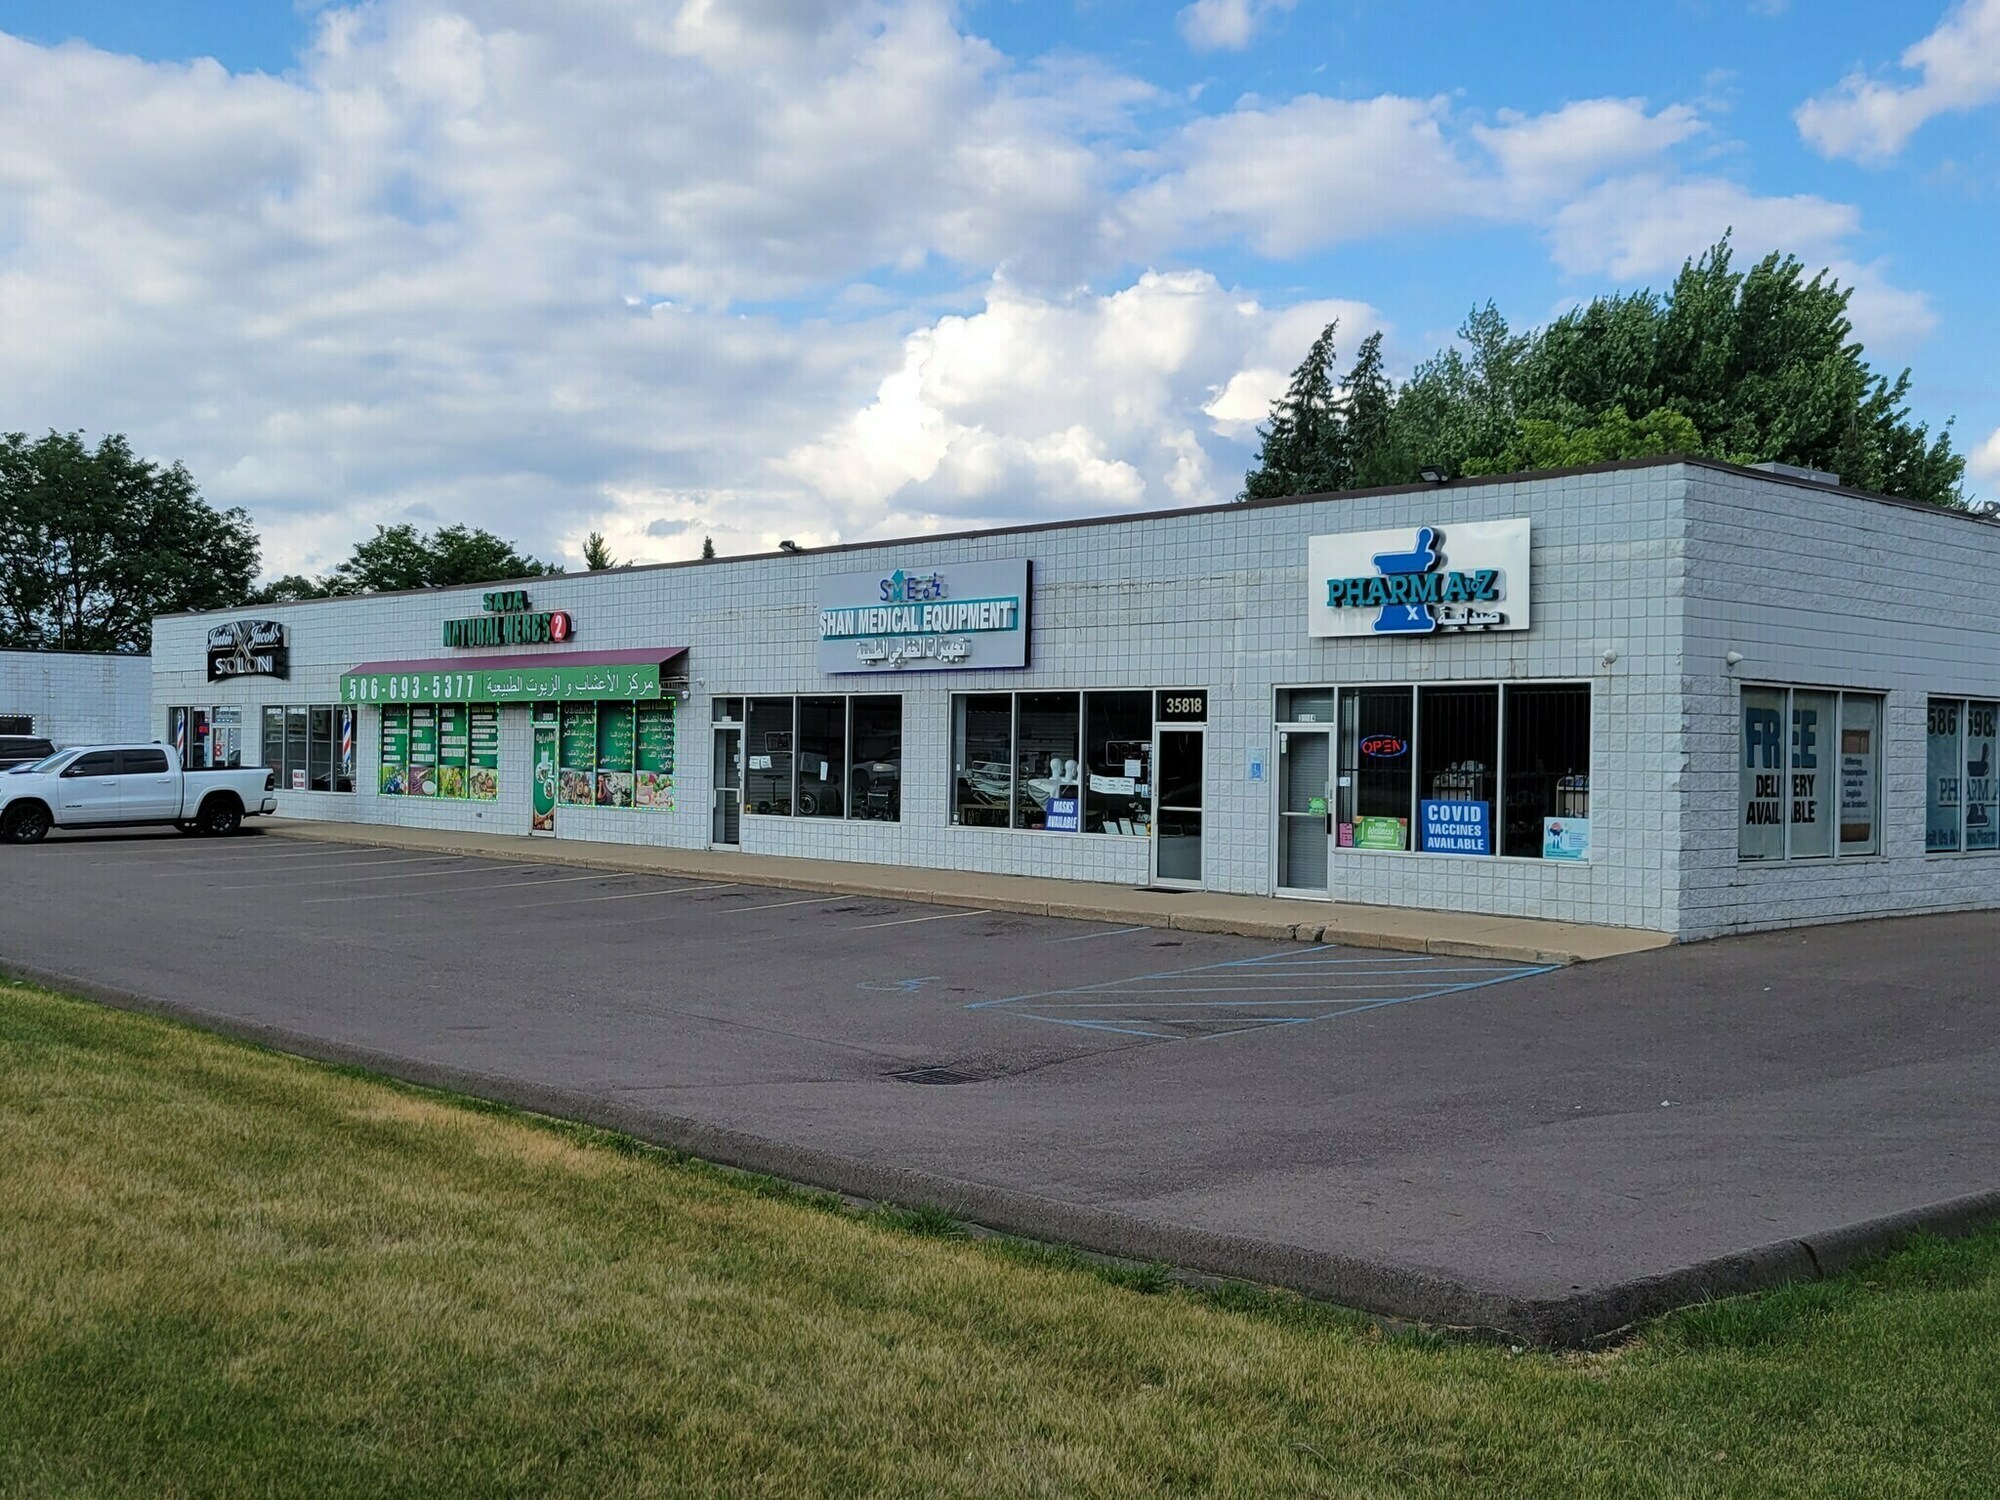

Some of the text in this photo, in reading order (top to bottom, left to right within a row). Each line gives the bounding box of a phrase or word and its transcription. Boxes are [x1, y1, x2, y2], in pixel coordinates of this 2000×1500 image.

[443, 612, 563, 648] NATURAL HERBS 2
[819, 600, 1012, 637] SHAN MEDICAL EQUIPMENT
[486, 675, 523, 698] الطبيعية
[526, 673, 561, 697] الزيوت
[623, 672, 654, 697] مركز
[1166, 697, 1203, 713] 35818
[1362, 739, 1401, 754] OPEN
[1745, 707, 1817, 769] FREE
[1755, 774, 1816, 798] DELIERY
[1053, 800, 1074, 814] MASKS
[1428, 805, 1481, 822] COVID
[1746, 801, 1817, 825] AVAILBLE
[1047, 815, 1077, 829] AVAILABLE
[1428, 823, 1482, 836] VACCINES
[1427, 837, 1484, 851] AVAILABLE
